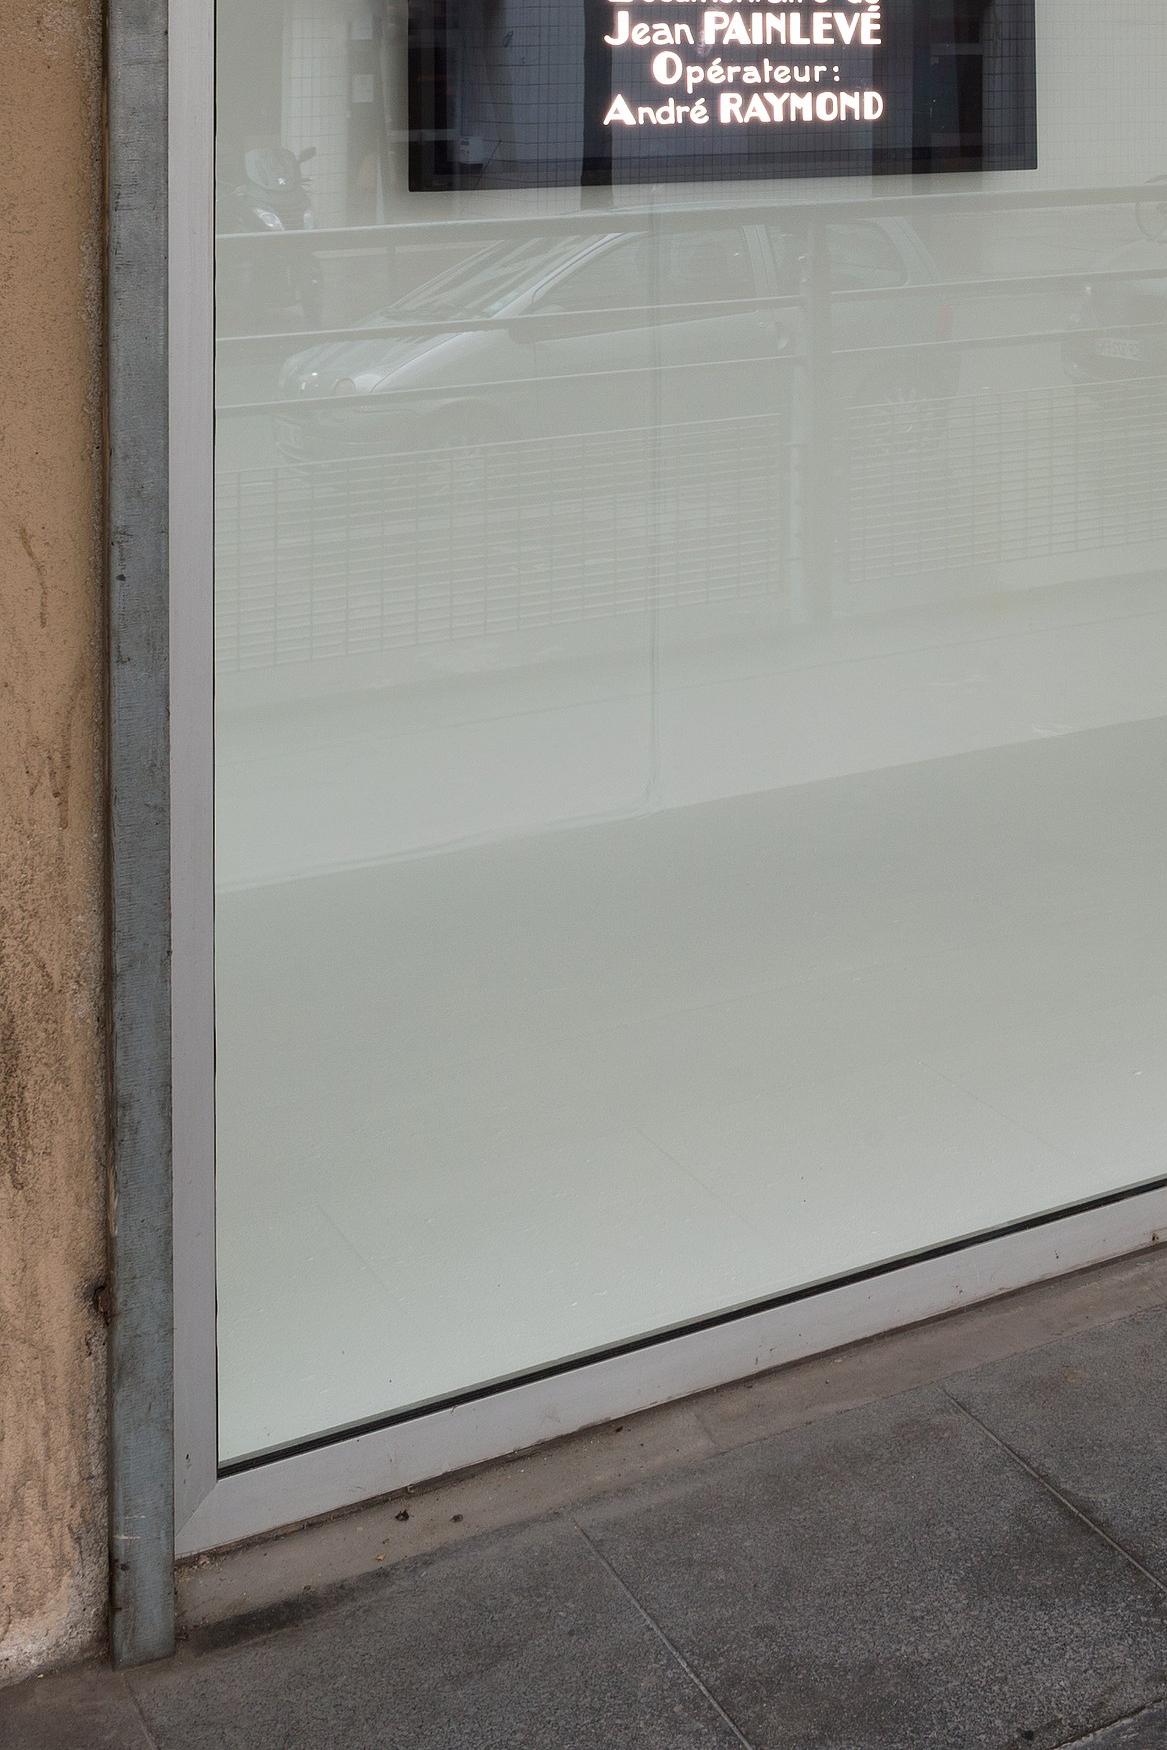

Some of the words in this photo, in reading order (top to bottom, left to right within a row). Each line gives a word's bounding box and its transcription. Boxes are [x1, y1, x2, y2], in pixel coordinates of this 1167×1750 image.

[603, 10, 695, 47] Jean
[703, 5, 882, 47] PAINLEVÉ
[651, 50, 841, 95] Opérateur:
[602, 93, 710, 126] André
[718, 91, 884, 124] RAYMOND
